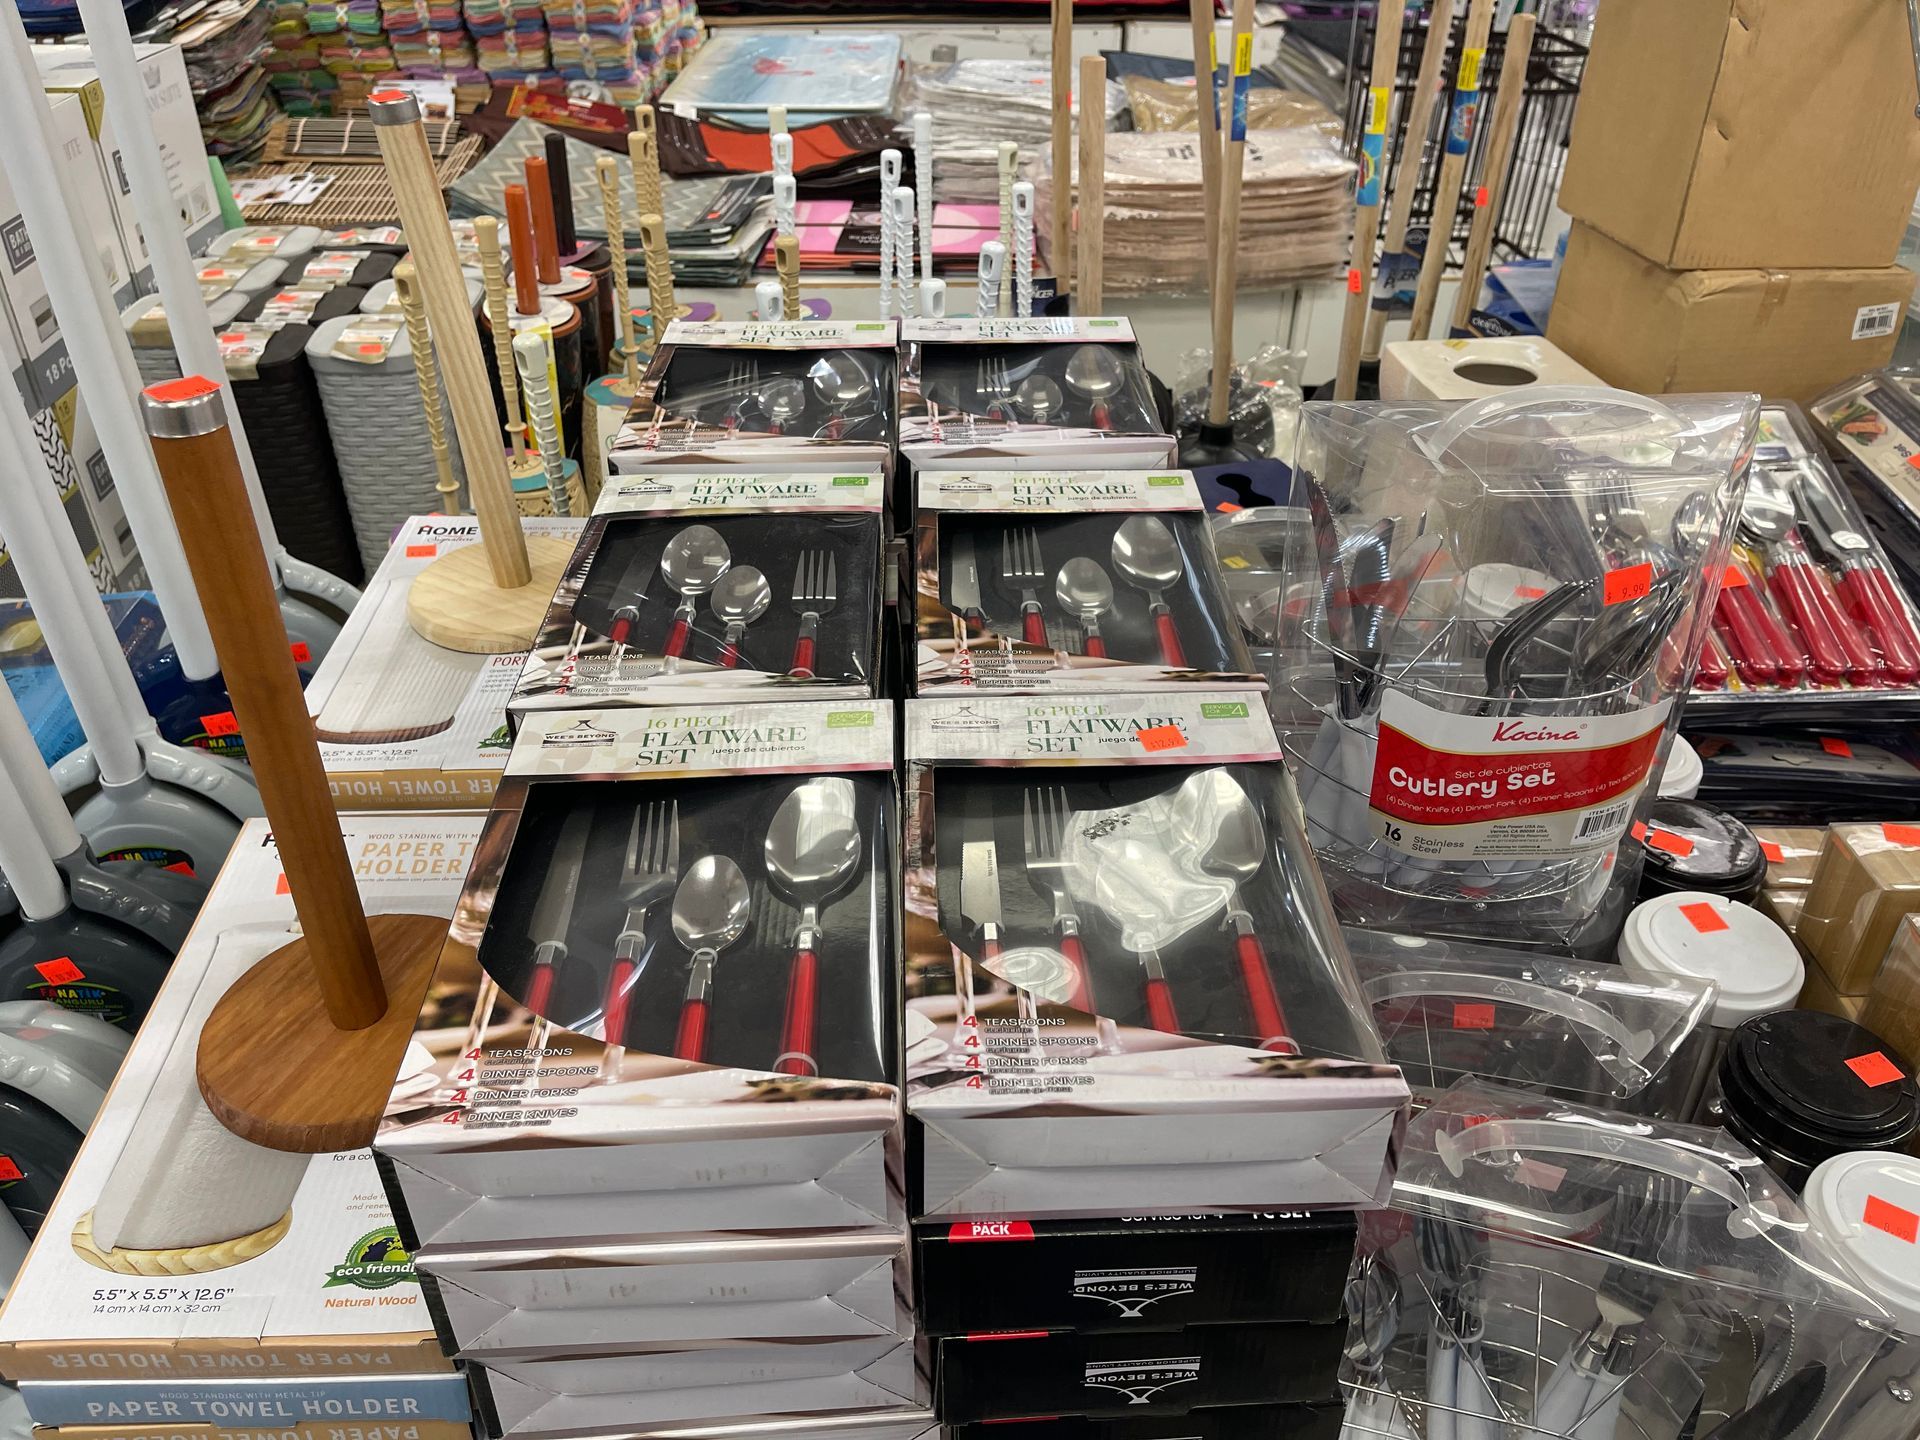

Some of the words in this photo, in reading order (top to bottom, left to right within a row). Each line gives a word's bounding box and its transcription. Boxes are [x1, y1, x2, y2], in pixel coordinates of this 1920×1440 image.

[743, 329, 844, 337] FLATWARE
[45, 364, 60, 385] 18
[693, 484, 818, 495] FLATWARE
[1013, 485, 1136, 494] FLATWARE
[688, 495, 734, 505] SET
[1012, 496, 1056, 506] SET
[417, 526, 478, 536] HOME
[1622, 583, 1644, 599] 9.99
[566, 654, 580, 662] 4
[563, 665, 575, 673] 4
[961, 678, 972, 686] 4
[554, 687, 569, 695] 4
[1026, 706, 1046, 716] 16
[1050, 705, 1110, 716] PIECE
[1232, 704, 1245, 716] 4
[647, 718, 667, 730] 16
[674, 716, 735, 728] PIECE
[858, 713, 872, 726] 4
[1026, 717, 1187, 734] FLATWARE
[640, 726, 806, 748] FLATWARE
[1492, 720, 1581, 742] Kocina
[1027, 736, 1082, 752] SET
[1098, 736, 1126, 744] juego
[712, 747, 742, 756] juego
[759, 744, 806, 753] cubiertos
[635, 748, 696, 766] SET
[1455, 770, 1475, 780] Set
[1478, 769, 1494, 778] de
[1496, 761, 1552, 776] cubiertos
[389, 780, 460, 796] TOWEL
[1389, 767, 1498, 798] Cutlery
[1506, 768, 1556, 790] Set
[1386, 794, 1396, 804] (4)
[1398, 798, 1424, 812] Dinner
[1452, 805, 1464, 814] (4)
[1466, 801, 1494, 812] Dinner
[1496, 800, 1516, 808] Fork
[1518, 798, 1531, 806] (4)
[1532, 794, 1562, 803] Dinner
[1385, 822, 1402, 842] 16
[1414, 836, 1464, 848] Stainless
[361, 842, 445, 857] PAPER
[1412, 844, 1442, 854] Steel
[355, 859, 462, 875] HOLDER
[40, 988, 102, 999] FANATIK
[963, 1016, 979, 1028] 4
[984, 1018, 1066, 1027] TEASPOONS
[964, 1036, 980, 1048] 4
[986, 1037, 1038, 1047] DINNER
[1040, 1036, 1098, 1046] SPOONS
[465, 1048, 481, 1061] 4
[489, 1048, 573, 1058] TEASPOONS
[964, 1056, 982, 1068] 4
[987, 1057, 1039, 1067] DINNER
[1042, 1056, 1088, 1066] FORKS
[458, 1068, 474, 1082] 4
[481, 1070, 534, 1080] DINNER
[536, 1066, 598, 1078] SPOONS
[966, 1076, 983, 1089] 4
[988, 1078, 1042, 1088] DINNER
[1044, 1076, 1094, 1086] KNIVES
[450, 1090, 467, 1103] 4
[474, 1089, 528, 1100] DINNER
[530, 1088, 578, 1098] FORKS
[442, 1110, 460, 1124] 4
[466, 1110, 522, 1122] DINNER
[524, 1108, 578, 1118] KNIVES
[332, 1154, 348, 1162] for
[972, 1224, 1010, 1236] PACK
[336, 1266, 362, 1277] eco
[1150, 1268, 1198, 1276] SUPERIOR
[1074, 1284, 1138, 1294] BEYOND
[1146, 1282, 1192, 1291] WEE'S
[92, 1288, 127, 1300] 5.5"
[128, 1292, 138, 1300] x
[142, 1288, 178, 1300] 5.5"
[180, 1292, 189, 1300] x
[194, 1288, 235, 1300] 12.6"
[325, 1298, 374, 1309] Natural
[378, 1294, 418, 1306] Wood
[93, 1304, 105, 1314] 14
[106, 1306, 127, 1314] cm
[138, 1304, 150, 1314] 14
[184, 1304, 198, 1313] 32
[48, 1353, 171, 1368] HOLDER
[180, 1353, 286, 1368] TOWEL
[295, 1352, 394, 1366] PAPER
[1086, 1374, 1146, 1383] BEYOND
[1151, 1371, 1196, 1380] WEE'S
[159, 1392, 190, 1400] WOOD
[192, 1392, 242, 1400] STANDING
[310, 1390, 326, 1398] TIP
[87, 1400, 180, 1418] PAPER
[184, 1400, 293, 1418] TOWEL
[302, 1398, 421, 1416] HOLDER
[328, 1426, 419, 1440] PAPER
